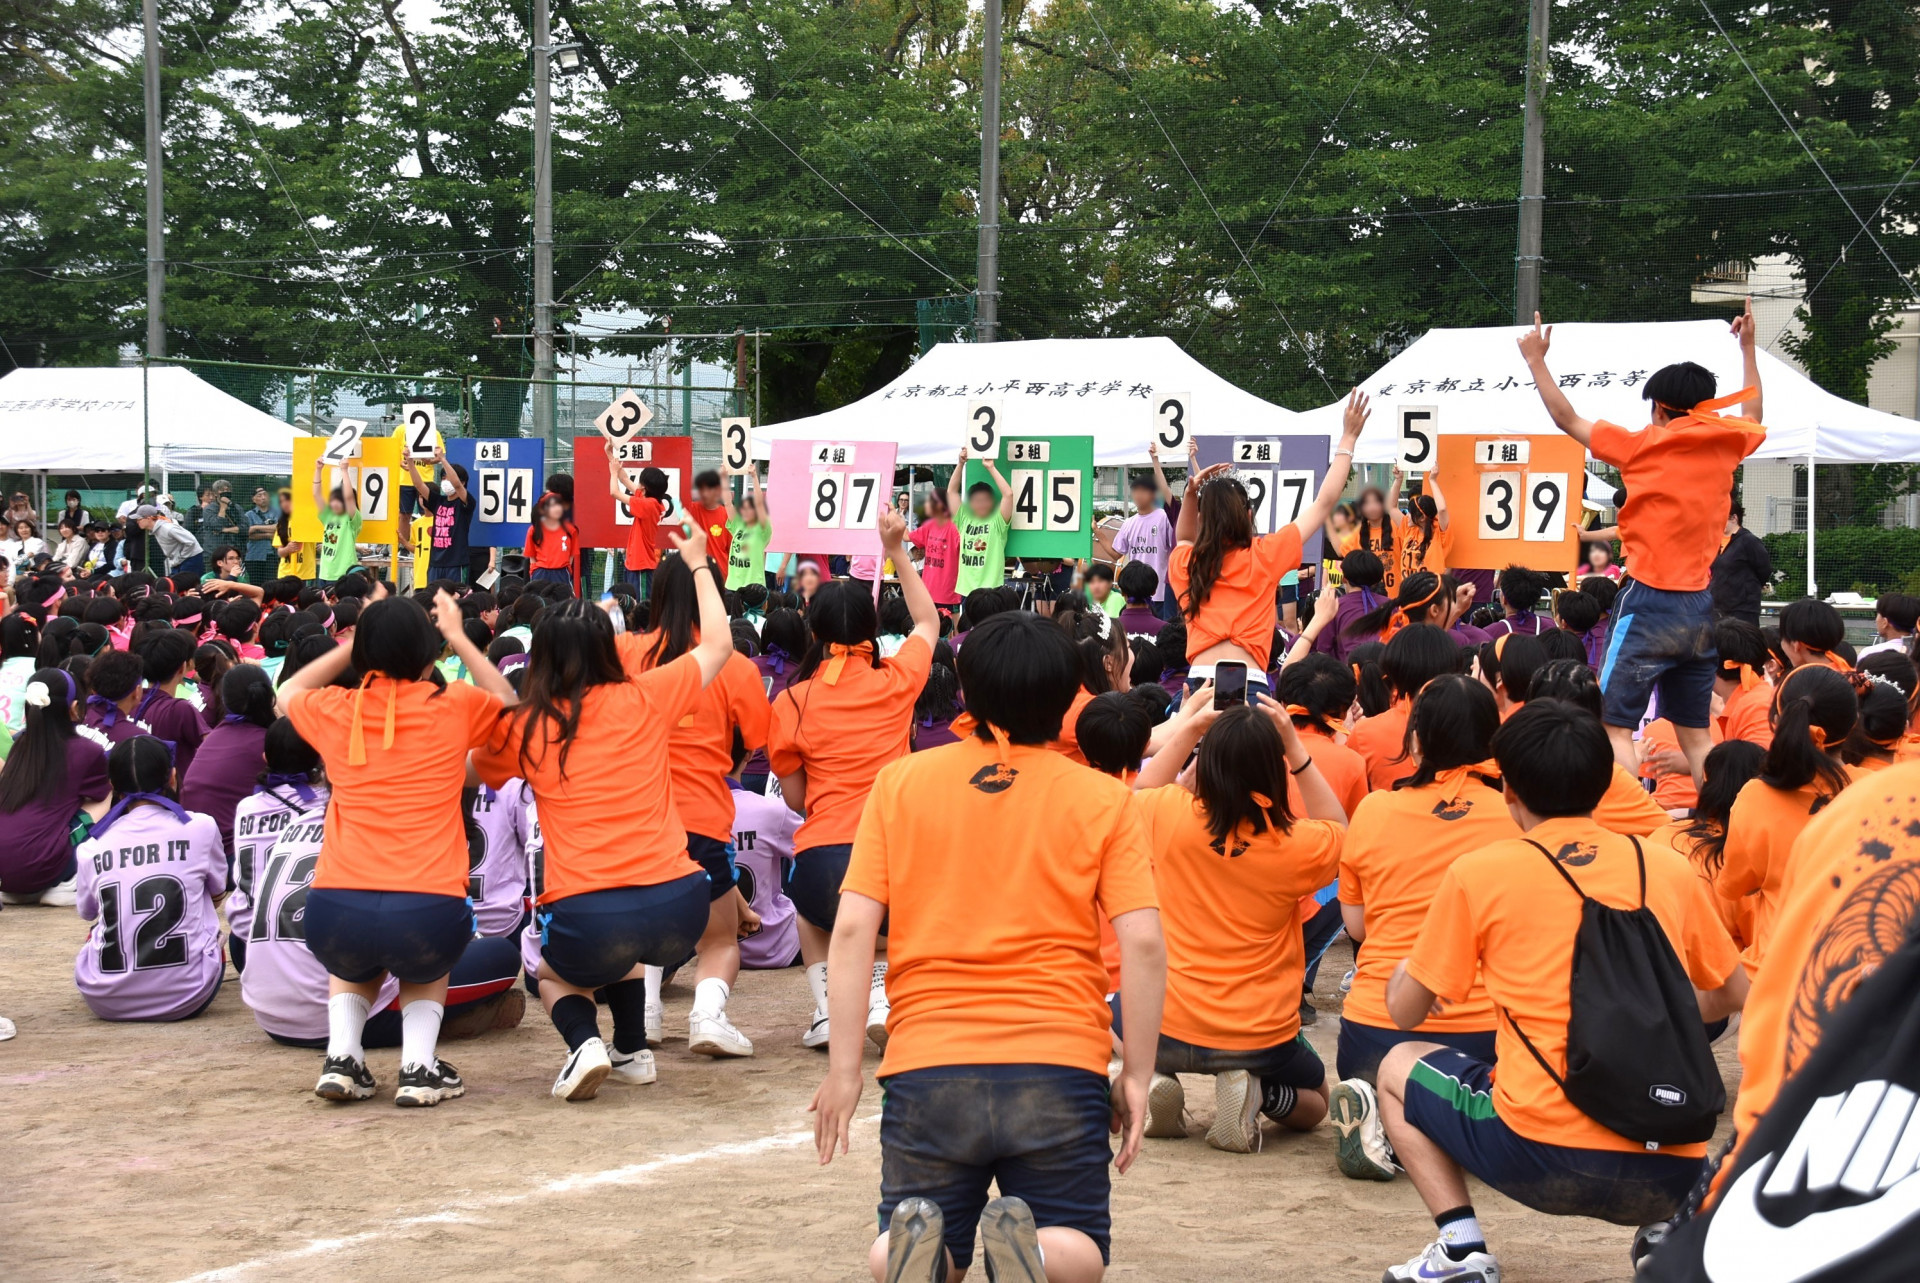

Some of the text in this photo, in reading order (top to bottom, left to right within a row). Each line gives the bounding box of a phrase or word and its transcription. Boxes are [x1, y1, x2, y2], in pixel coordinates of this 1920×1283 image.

[409, 410, 433, 452] 2
[605, 401, 641, 437] 3
[971, 406, 995, 452] 3
[1159, 399, 1184, 448] 3
[1403, 412, 1430, 463] 5
[327, 425, 357, 459] 2
[727, 424, 746, 469] 3
[365, 473, 383, 514] 9
[815, 478, 875, 522] 87
[1016, 476, 1075, 524] 45
[1485, 479, 1560, 534] 39
[961, 554, 985, 567] SWAG
[240, 815, 255, 836] GO
[281, 824, 325, 843] GO FO
[737, 830, 757, 851] IT
[93, 839, 190, 875] GO FOR IT
[98, 873, 189, 975] 12
[1655, 1088, 1681, 1101] PUMA
